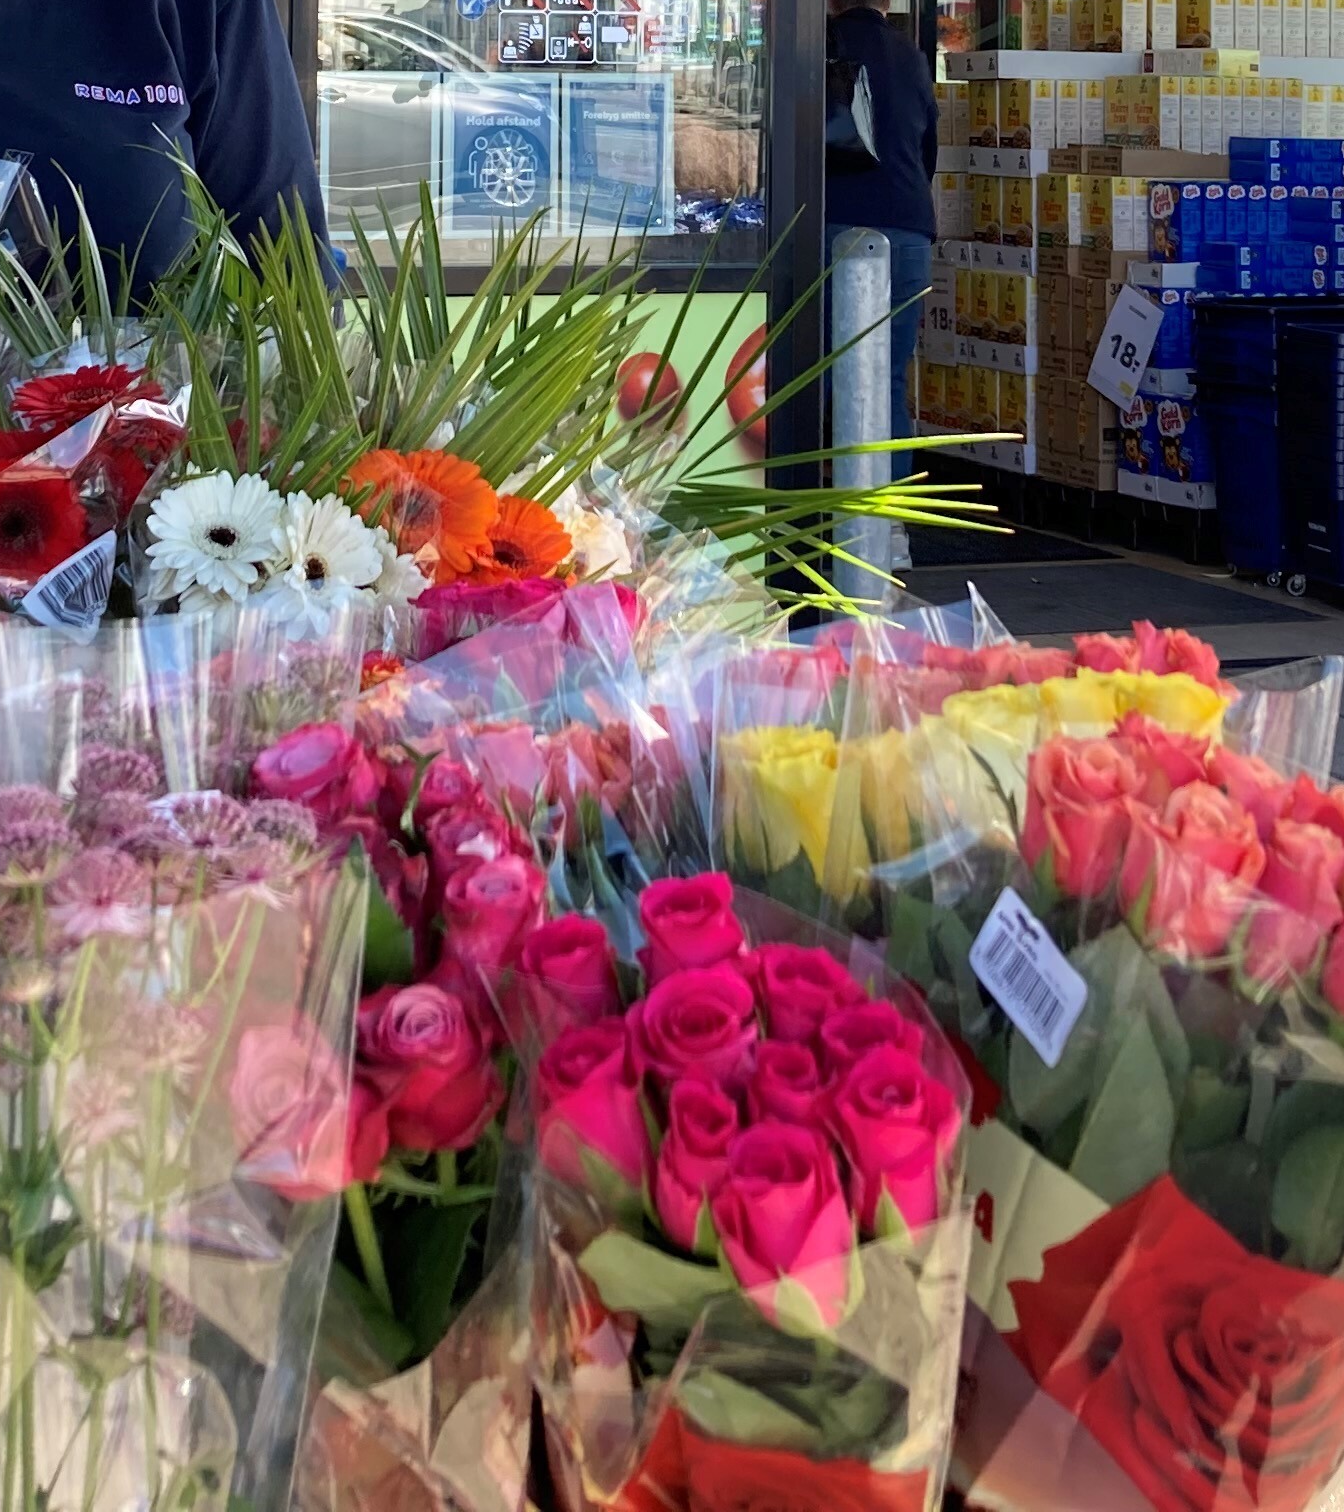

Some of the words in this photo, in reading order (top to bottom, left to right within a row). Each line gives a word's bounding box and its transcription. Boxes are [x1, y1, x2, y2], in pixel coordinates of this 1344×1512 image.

[74, 83, 140, 104] REMA
[144, 85, 185, 105] 100
[466, 115, 494, 126] Hold
[496, 116, 541, 127] afstand
[583, 111, 619, 121] Forebyg
